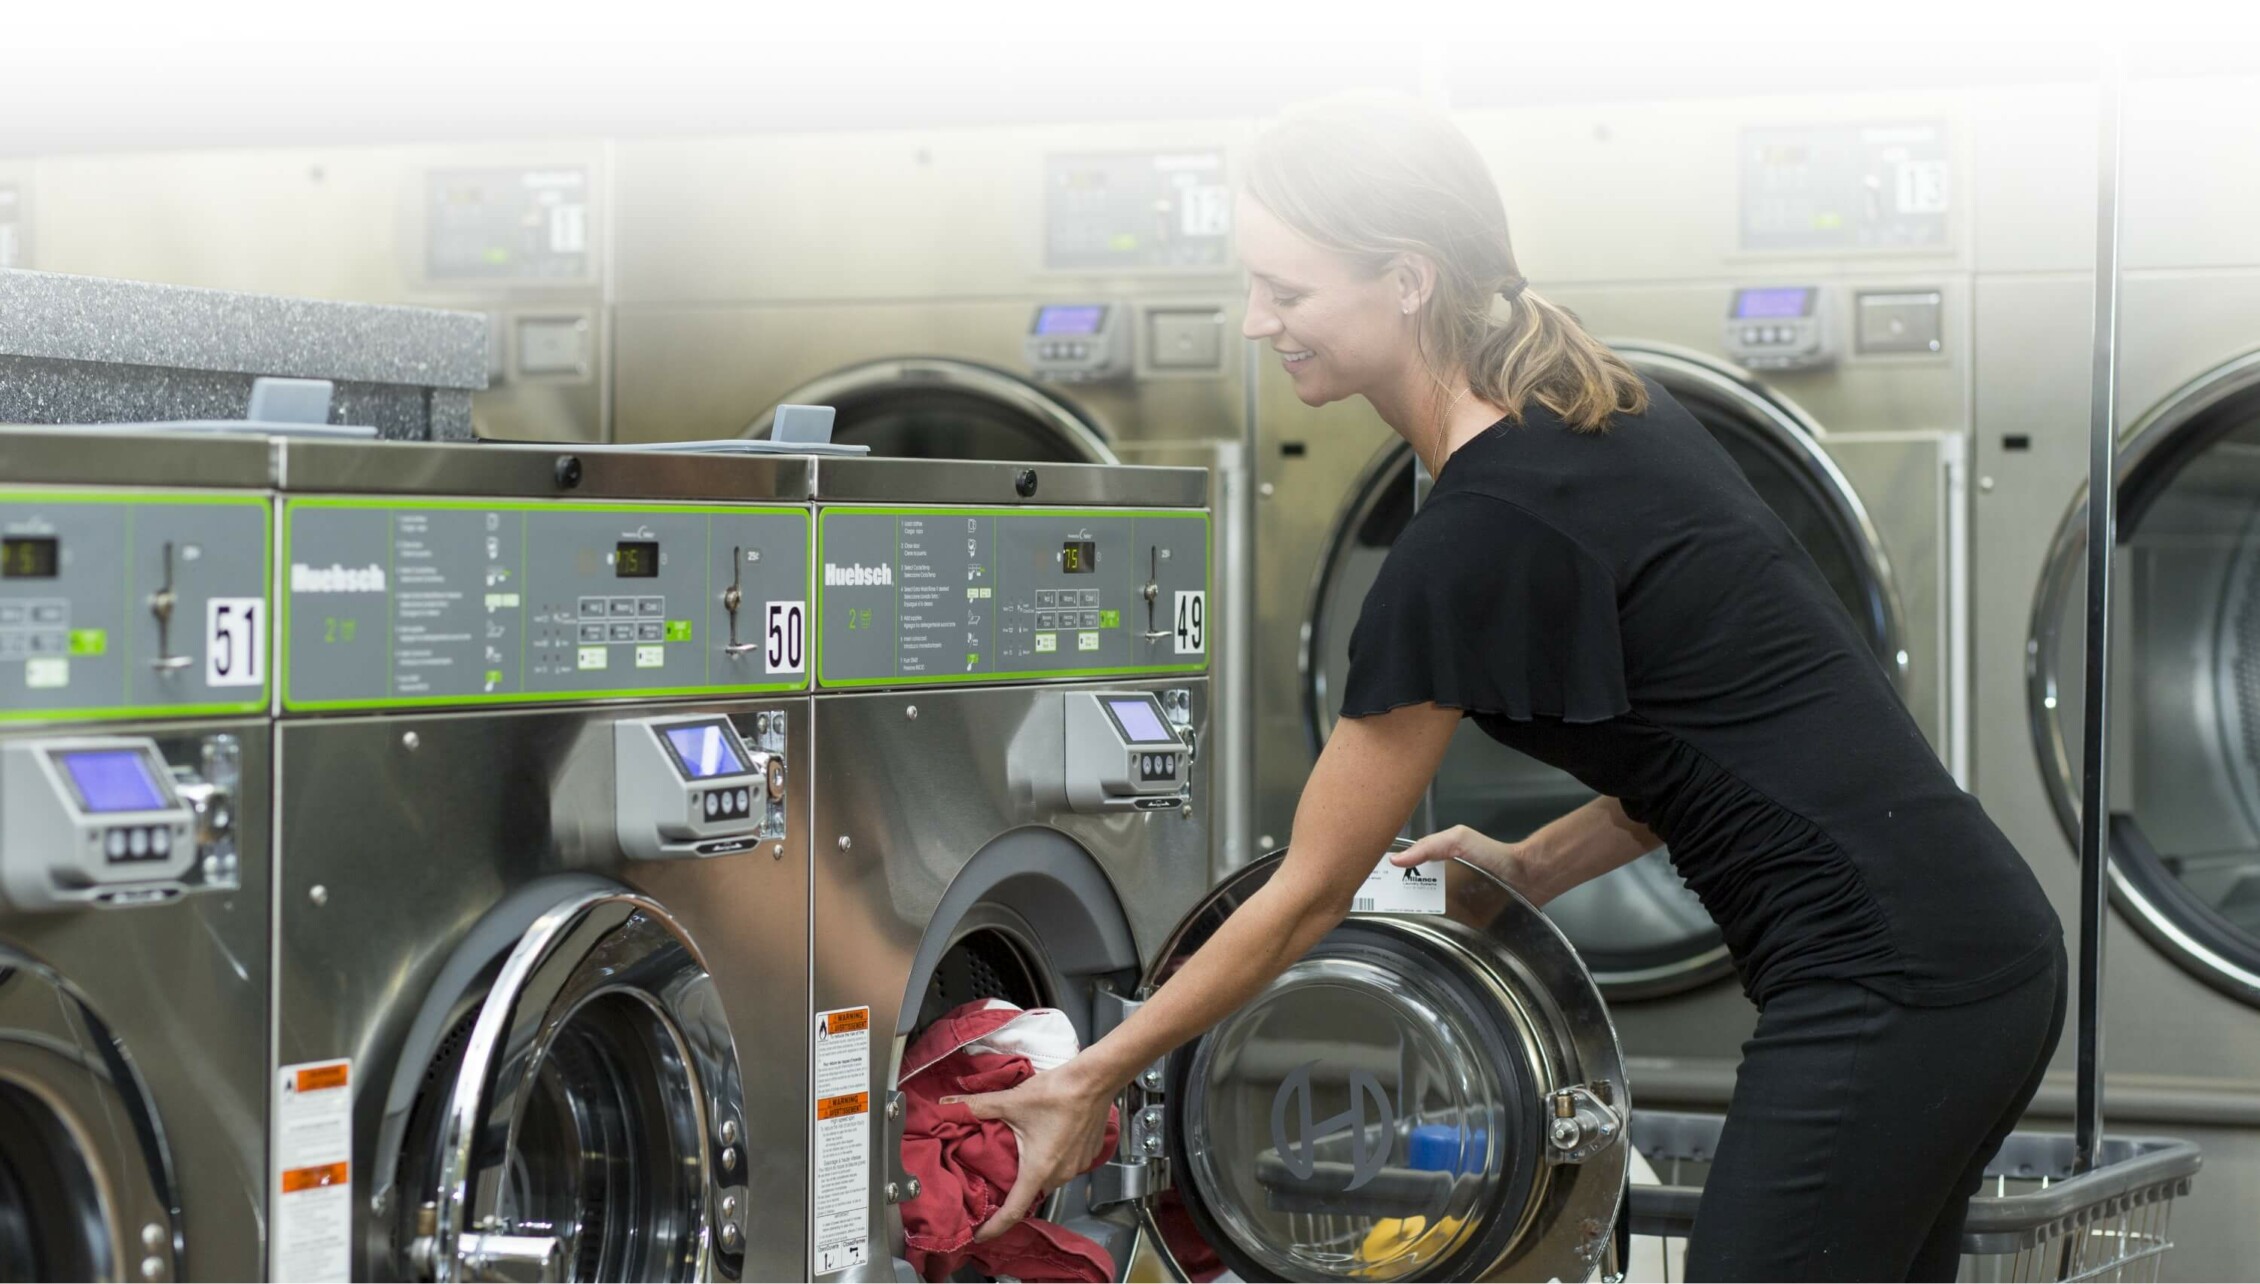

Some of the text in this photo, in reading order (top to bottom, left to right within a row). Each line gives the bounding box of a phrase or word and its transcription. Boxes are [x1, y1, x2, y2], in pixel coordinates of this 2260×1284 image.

[291, 563, 385, 592] Huebsch
[824, 562, 892, 586] Huebsch
[768, 605, 802, 668] 50
[1177, 595, 1202, 650] 49
[214, 606, 255, 677] 51
[838, 1011, 863, 1022] WARNING
[832, 1095, 858, 1106] WARNING
